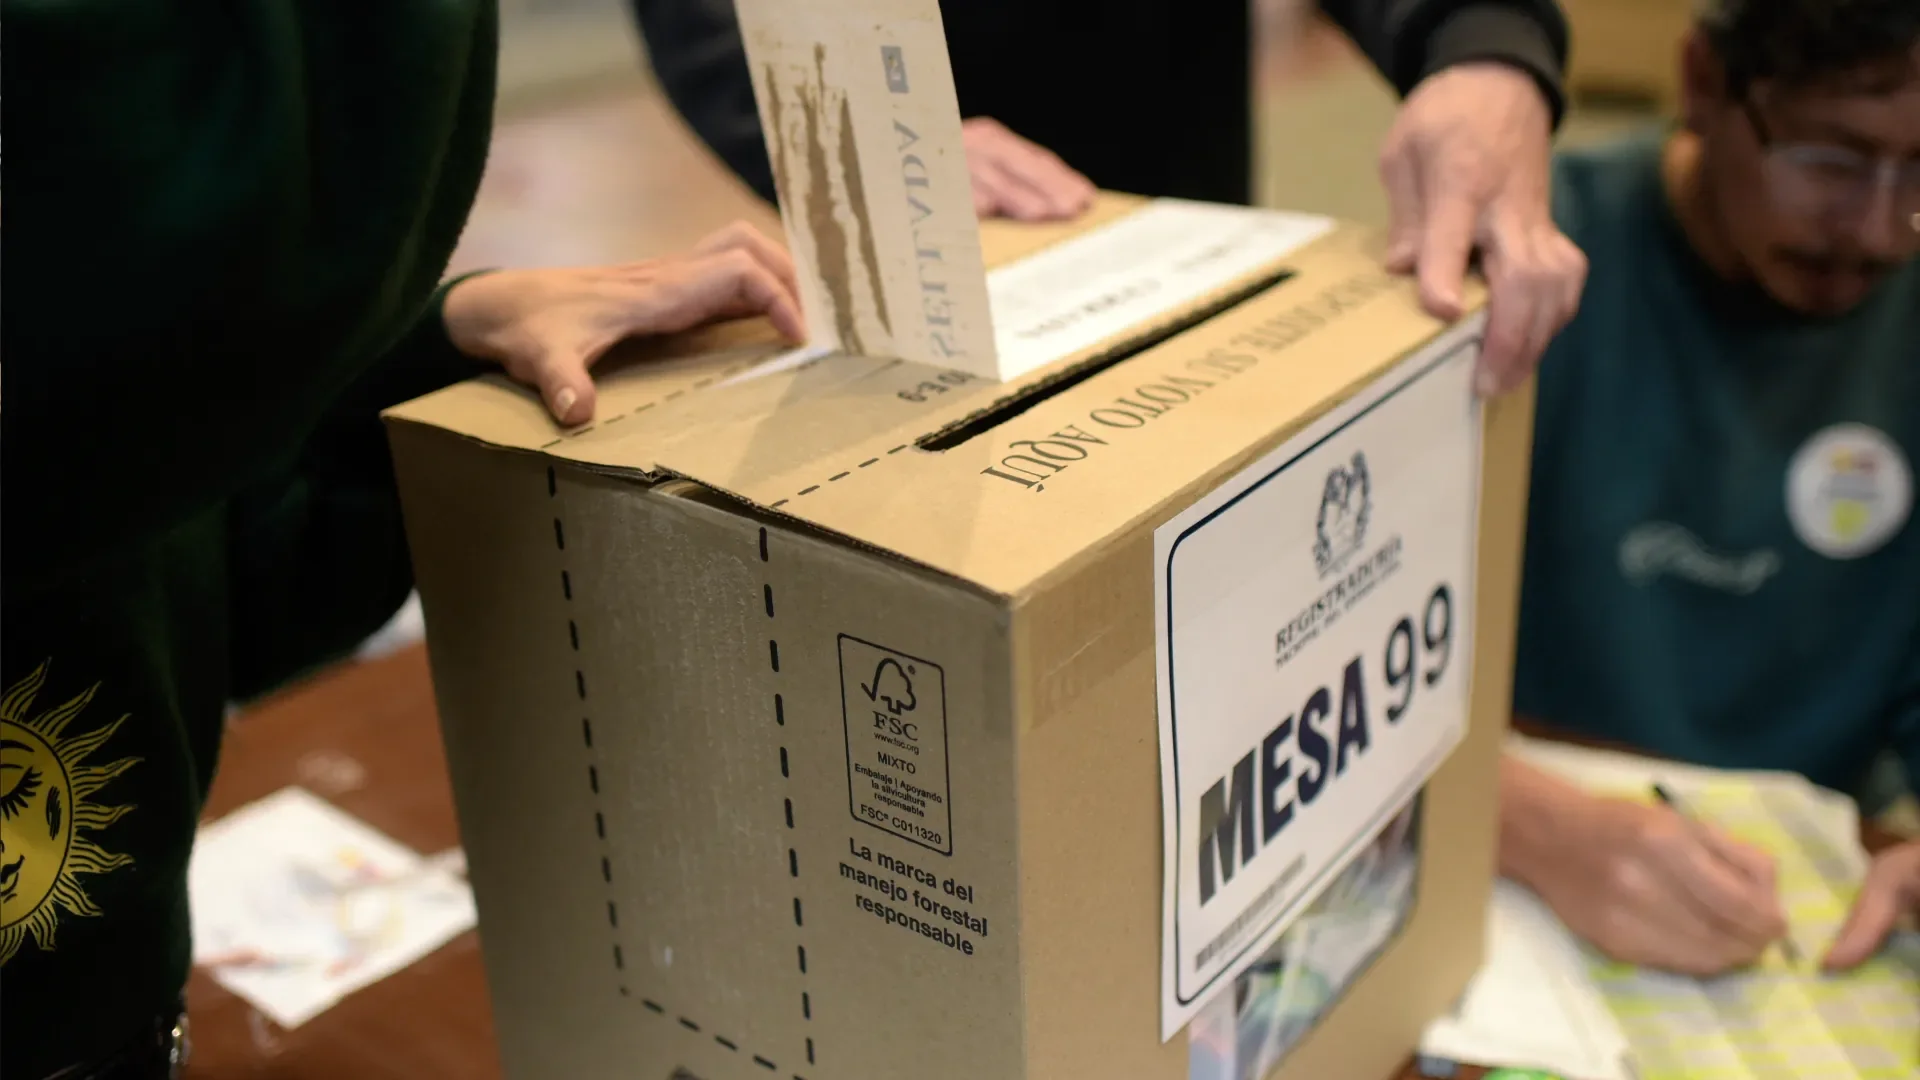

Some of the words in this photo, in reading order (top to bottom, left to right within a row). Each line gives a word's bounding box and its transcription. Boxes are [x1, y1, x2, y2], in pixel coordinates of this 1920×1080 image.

[1089, 374, 1216, 429] VOTO
[980, 424, 1110, 493] AQUÍ
[872, 711, 919, 742] FSC
[873, 732, 920, 756] www.fsc.org
[1198, 652, 1370, 908] MESA
[1385, 581, 1455, 725] 99
[854, 763, 893, 785] Embalaje
[900, 780, 943, 804] Apoyando
[877, 751, 916, 775] MIXTO
[871, 780, 880, 790] la
[881, 785, 926, 808] silvicultura
[874, 792, 925, 818] responsable
[892, 817, 942, 845] C011320
[850, 837, 872, 862] La
[877, 852, 937, 889] marca
[943, 878, 974, 904] del
[839, 862, 908, 902] manejo
[912, 890, 988, 937] forestal
[855, 893, 974, 956] responsable
